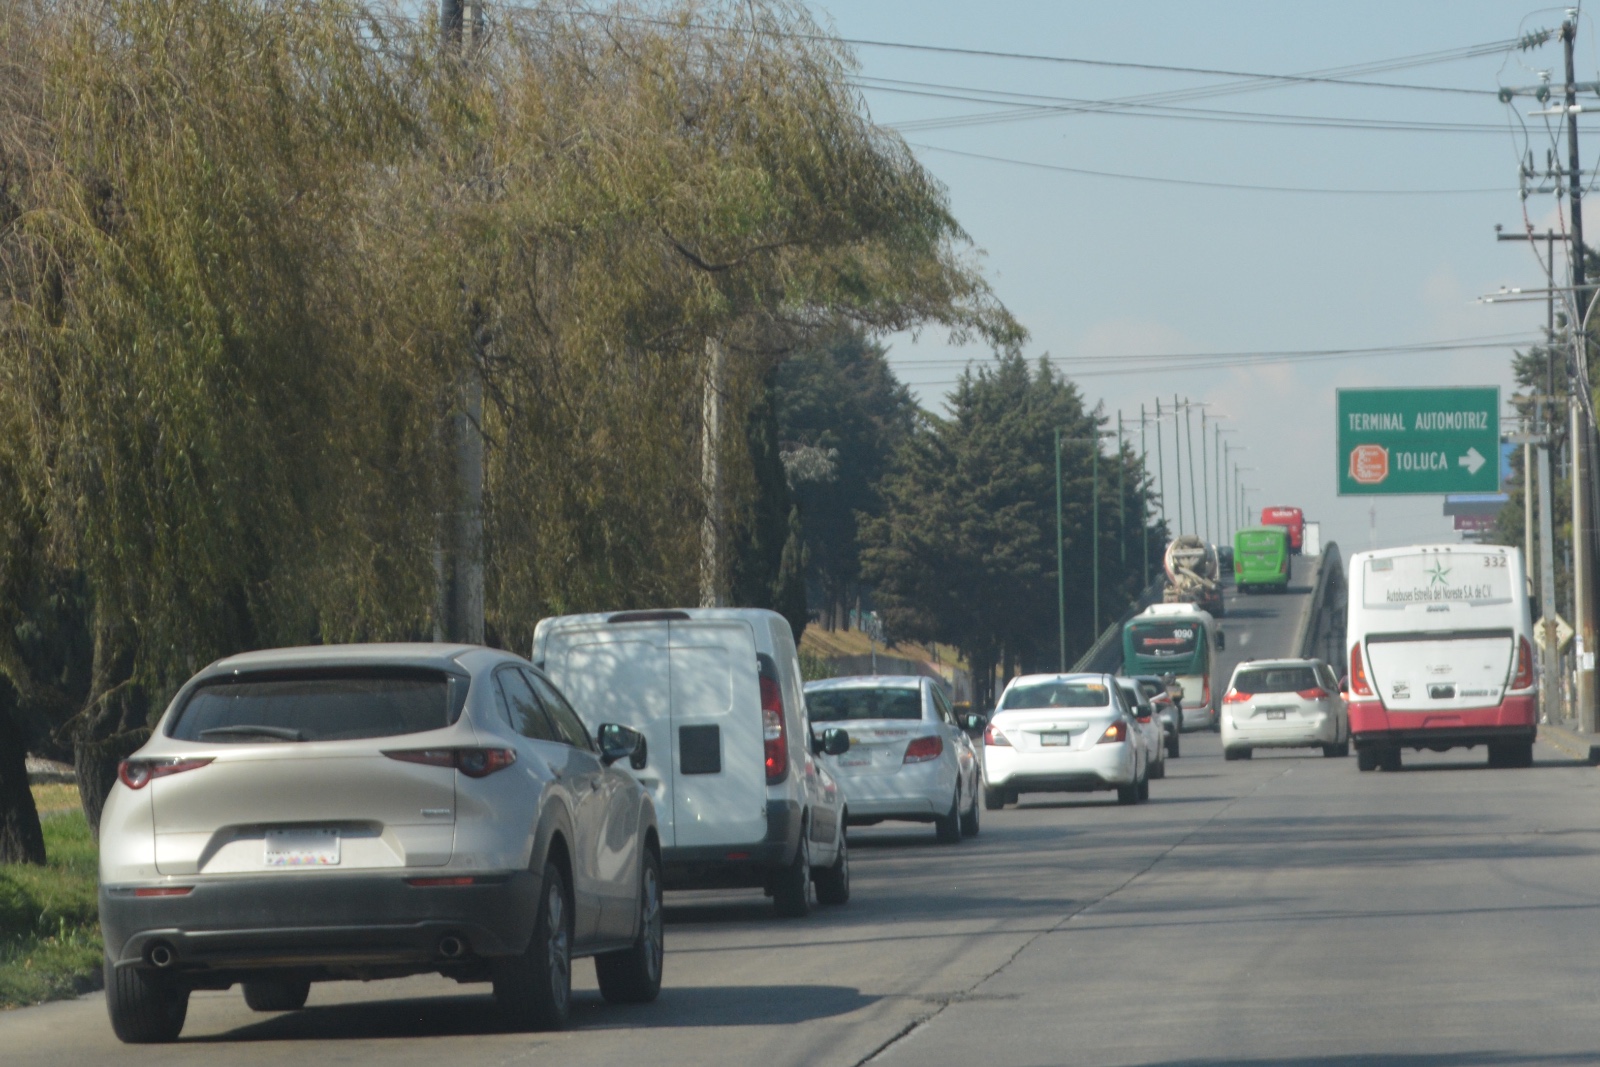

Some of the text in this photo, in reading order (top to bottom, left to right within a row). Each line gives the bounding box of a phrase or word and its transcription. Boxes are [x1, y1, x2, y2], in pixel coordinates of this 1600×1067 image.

[1349, 411, 1488, 430] TERMINAL AUTOMOTRIZ
[1396, 452, 1448, 470] TOLUCA
[1483, 556, 1506, 568] 332
[1387, 588, 1413, 602] Autobuses
[1414, 586, 1432, 601] Estrella
[1463, 584, 1474, 599] S.A.
[1475, 583, 1482, 598] de
[1173, 629, 1193, 639] 1090
